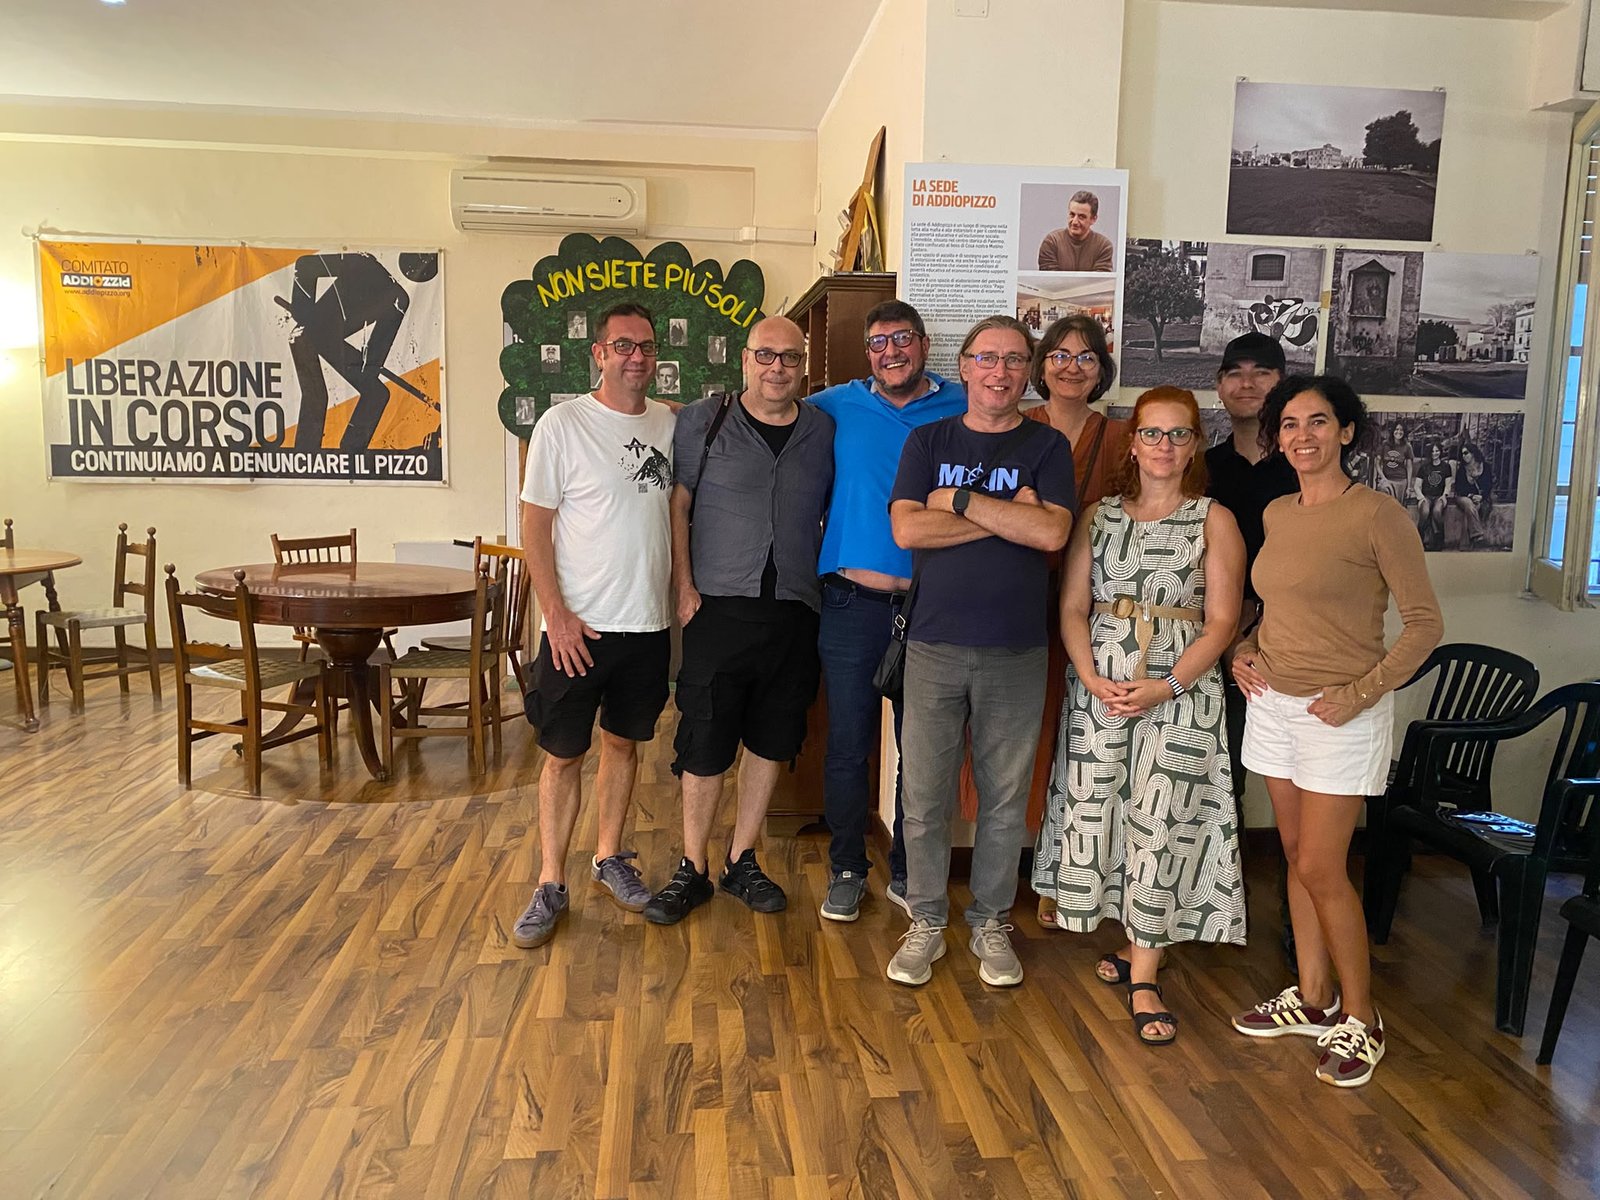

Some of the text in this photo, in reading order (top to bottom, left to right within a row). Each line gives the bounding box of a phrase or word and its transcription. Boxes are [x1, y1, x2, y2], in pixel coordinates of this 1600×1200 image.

[913, 179, 959, 193] LA SEDE
[912, 194, 997, 209] DI ADDIOPIZZO
[61, 259, 129, 274] COMITATO
[64, 289, 131, 297] www.addiopizzo.org
[537, 265, 585, 308] NON
[585, 259, 660, 291] SIETE
[704, 284, 758, 328] SOLI
[66, 358, 282, 399] LIBERAZIONE
[69, 399, 285, 448] IN CORSO
[71, 450, 428, 476] CONTINUIAMO A DENUNCIARE IL PIZZO
